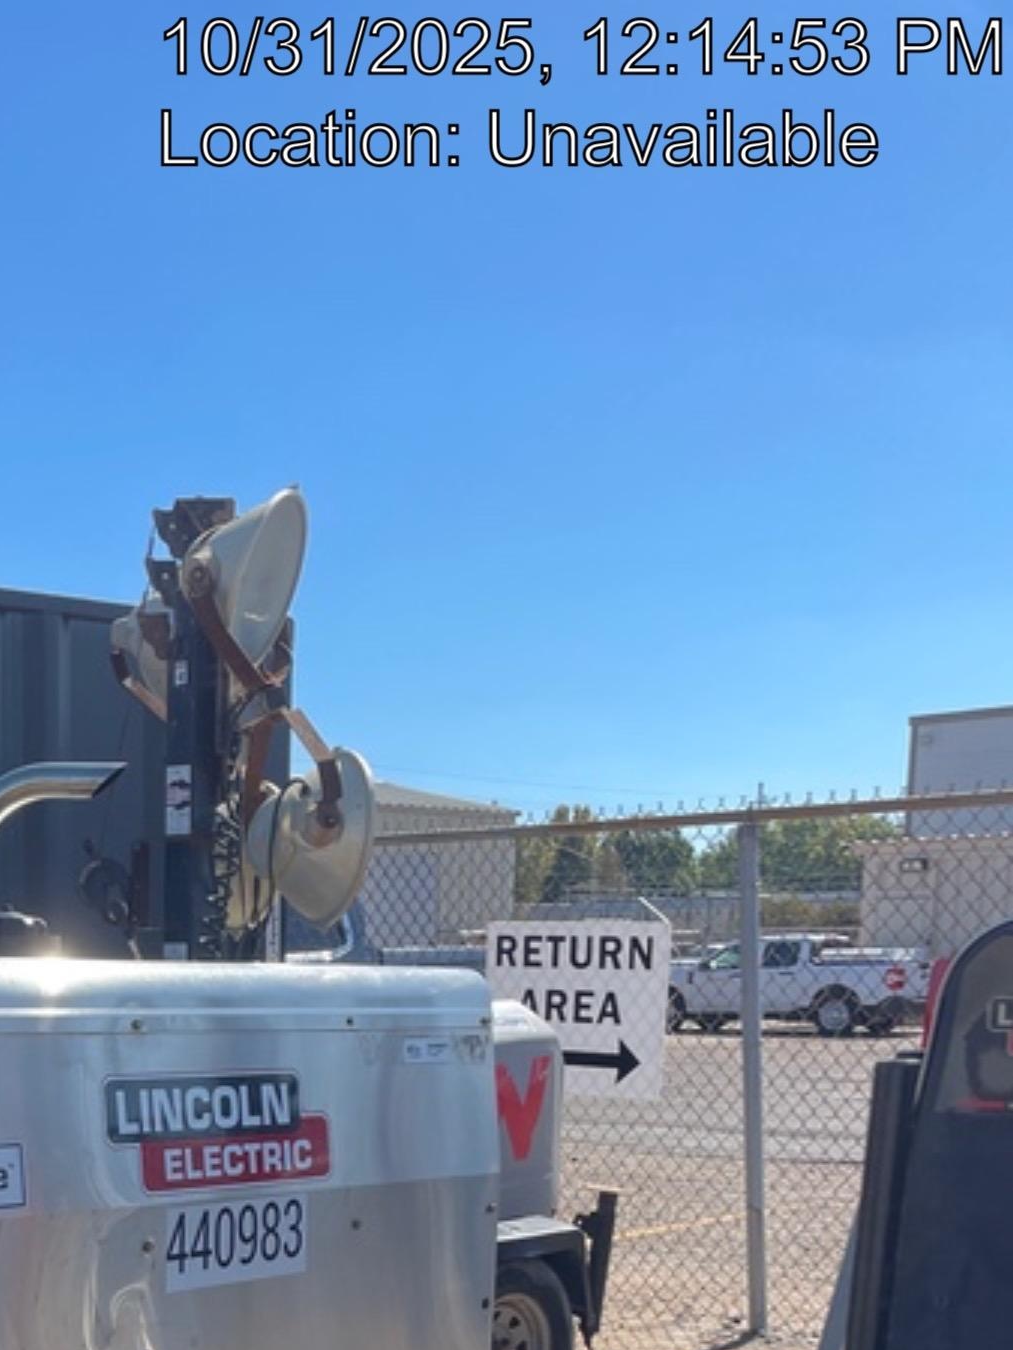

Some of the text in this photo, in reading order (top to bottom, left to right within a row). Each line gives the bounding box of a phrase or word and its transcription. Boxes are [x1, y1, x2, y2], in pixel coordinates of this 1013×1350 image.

[495, 934, 654, 970] RETURN
[114, 1083, 291, 1135] LINCOLN
[163, 1139, 313, 1182] ELECTRIC
[166, 1199, 303, 1274] 440983
